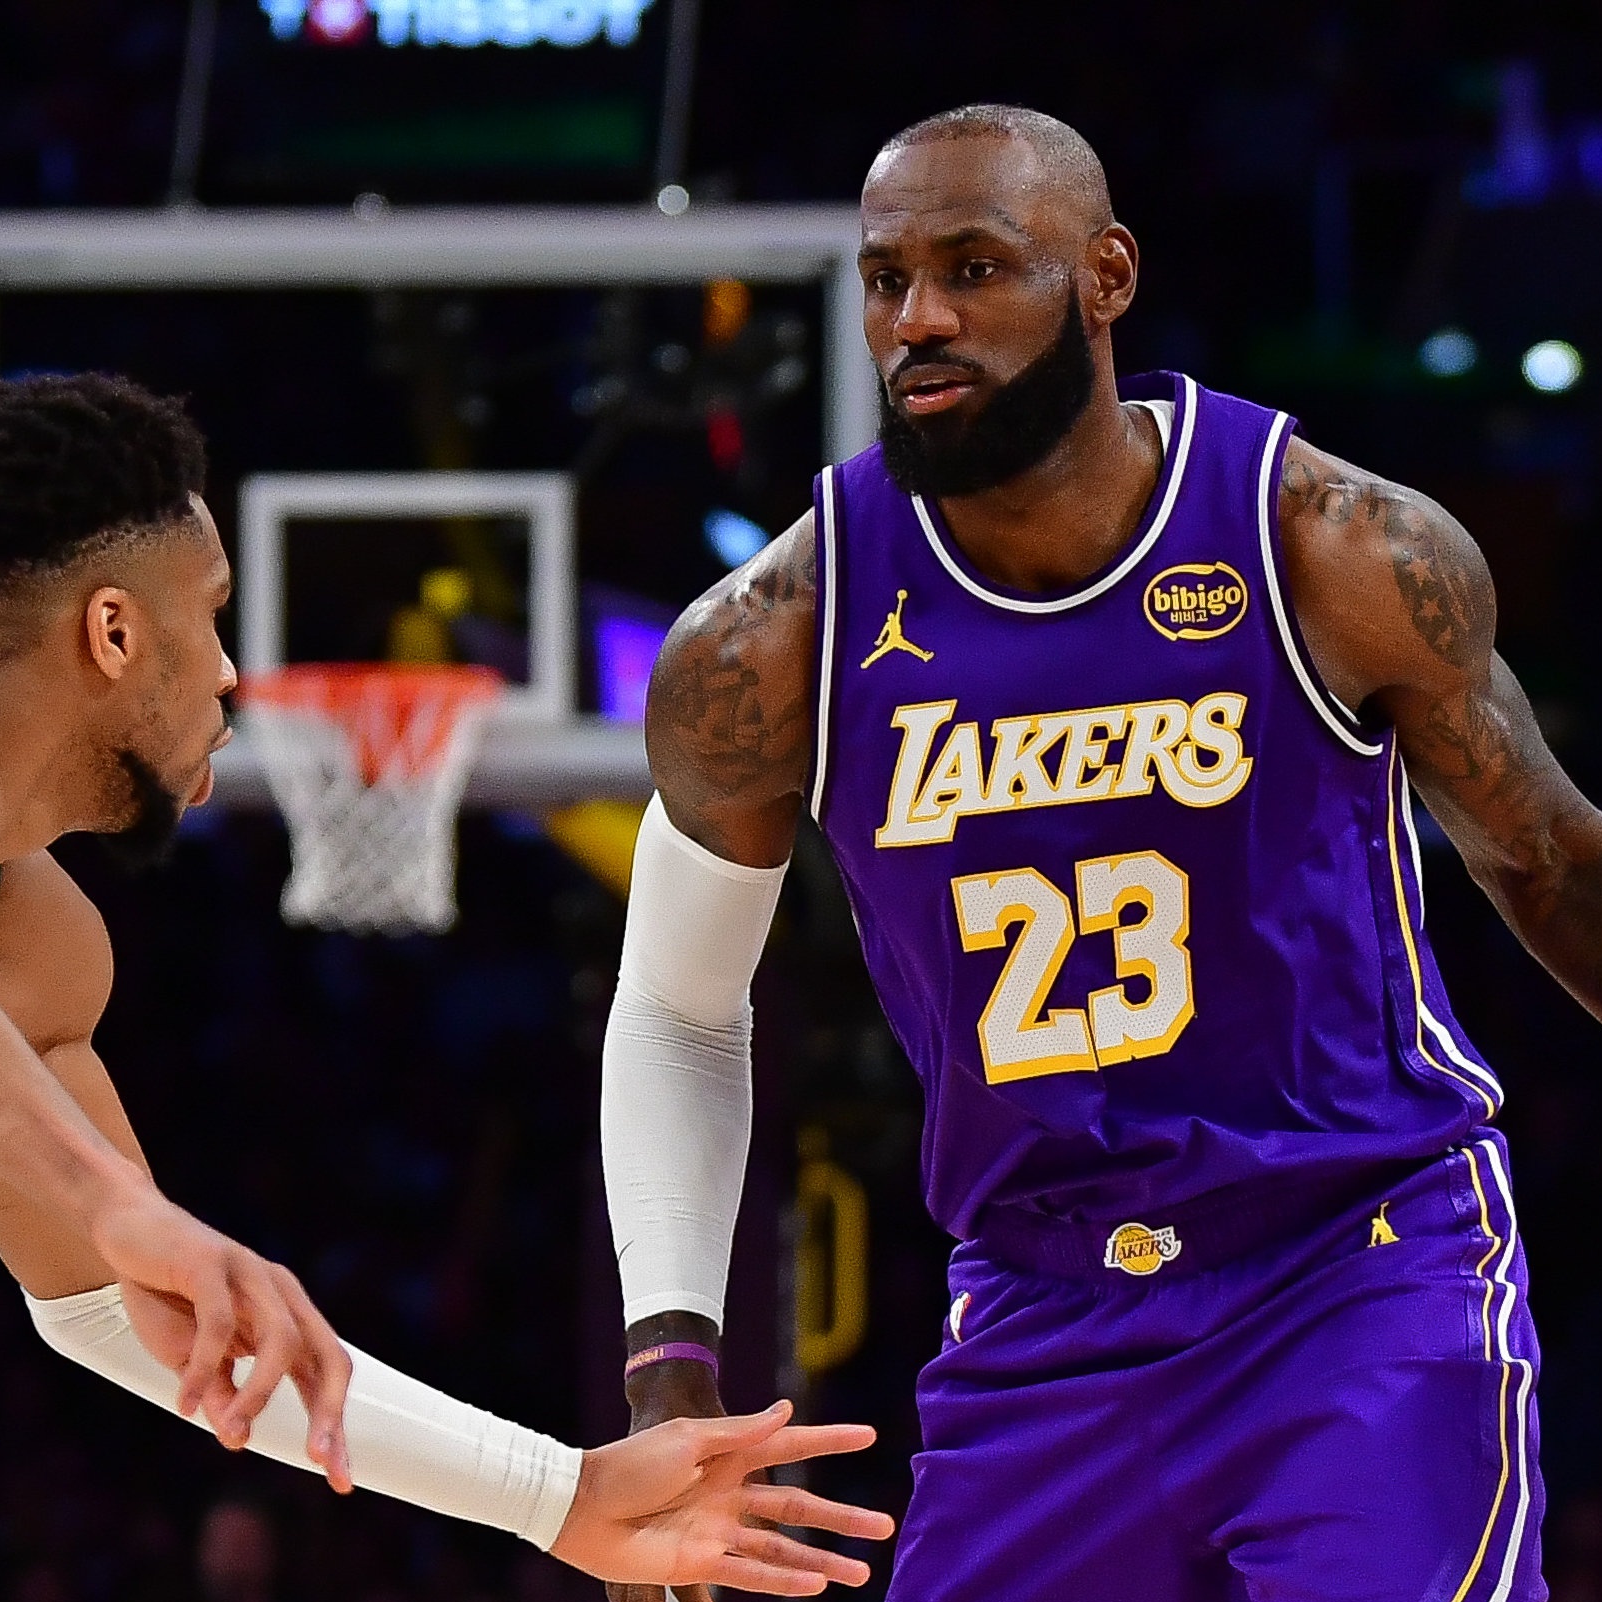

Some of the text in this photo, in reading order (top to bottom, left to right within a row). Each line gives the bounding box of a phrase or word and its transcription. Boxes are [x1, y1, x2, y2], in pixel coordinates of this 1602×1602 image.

[1153, 583, 1242, 616] bibigo
[1170, 609, 1209, 624] 비비고
[875, 691, 1254, 849] LAKERS
[950, 849, 1196, 1085] 23
[1105, 1234, 1180, 1265] LAKERS
